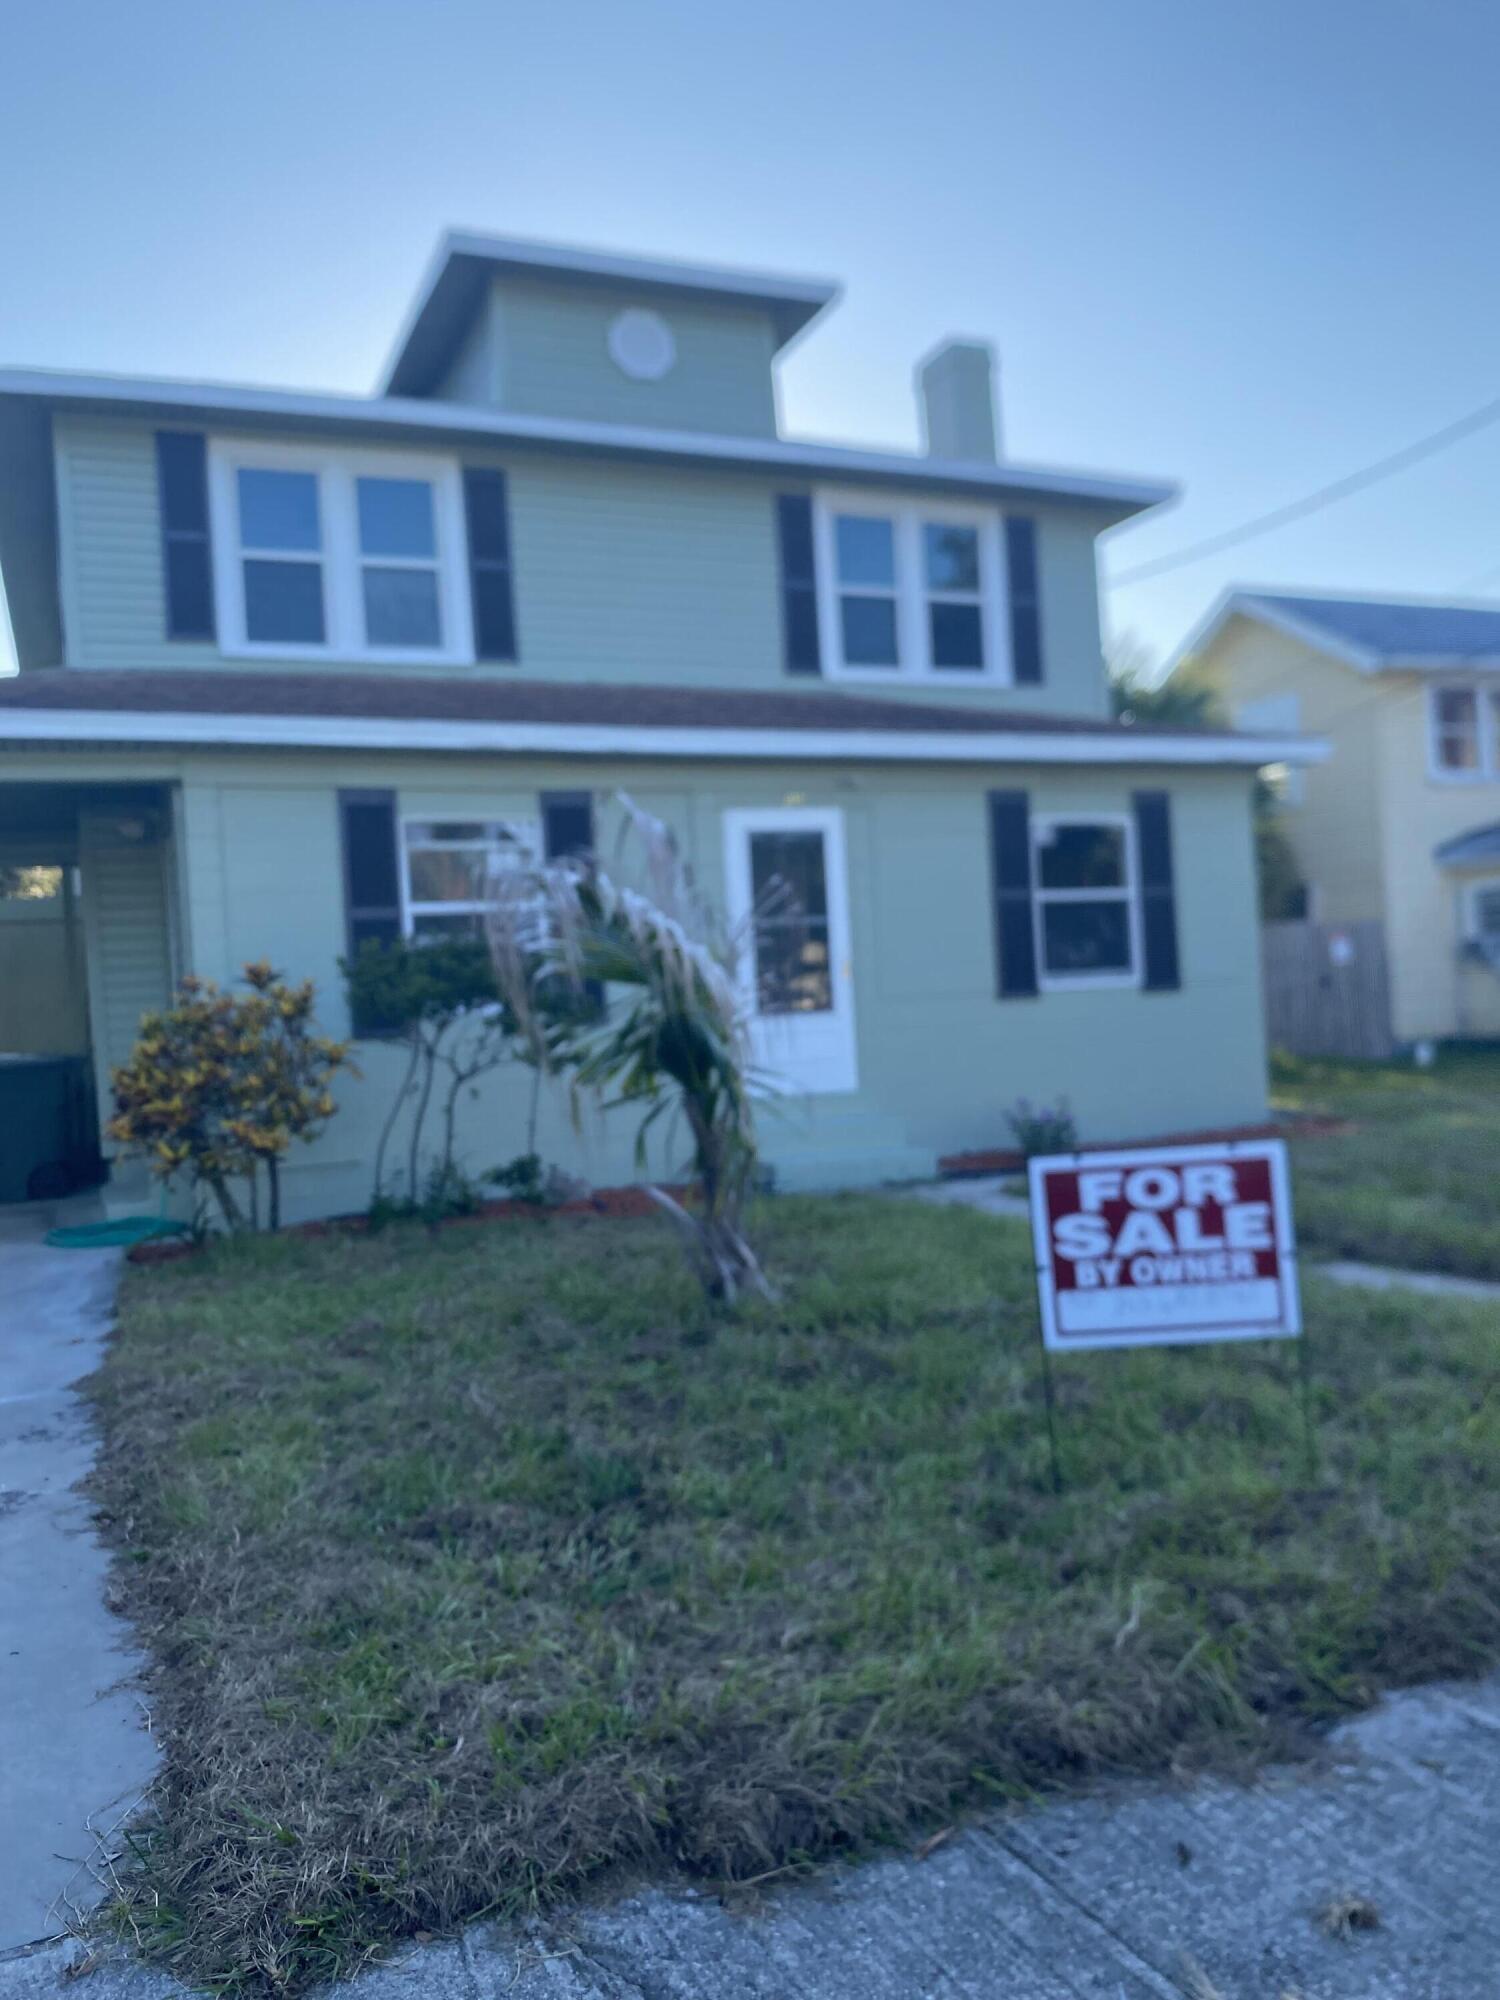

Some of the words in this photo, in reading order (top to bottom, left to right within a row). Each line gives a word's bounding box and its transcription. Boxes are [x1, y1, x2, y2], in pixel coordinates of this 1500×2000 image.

[1078, 1164, 1239, 1213] FOR
[1053, 1201, 1274, 1261] SALE
[1075, 1258, 1122, 1288] BY
[1130, 1252, 1257, 1286] OWNER
